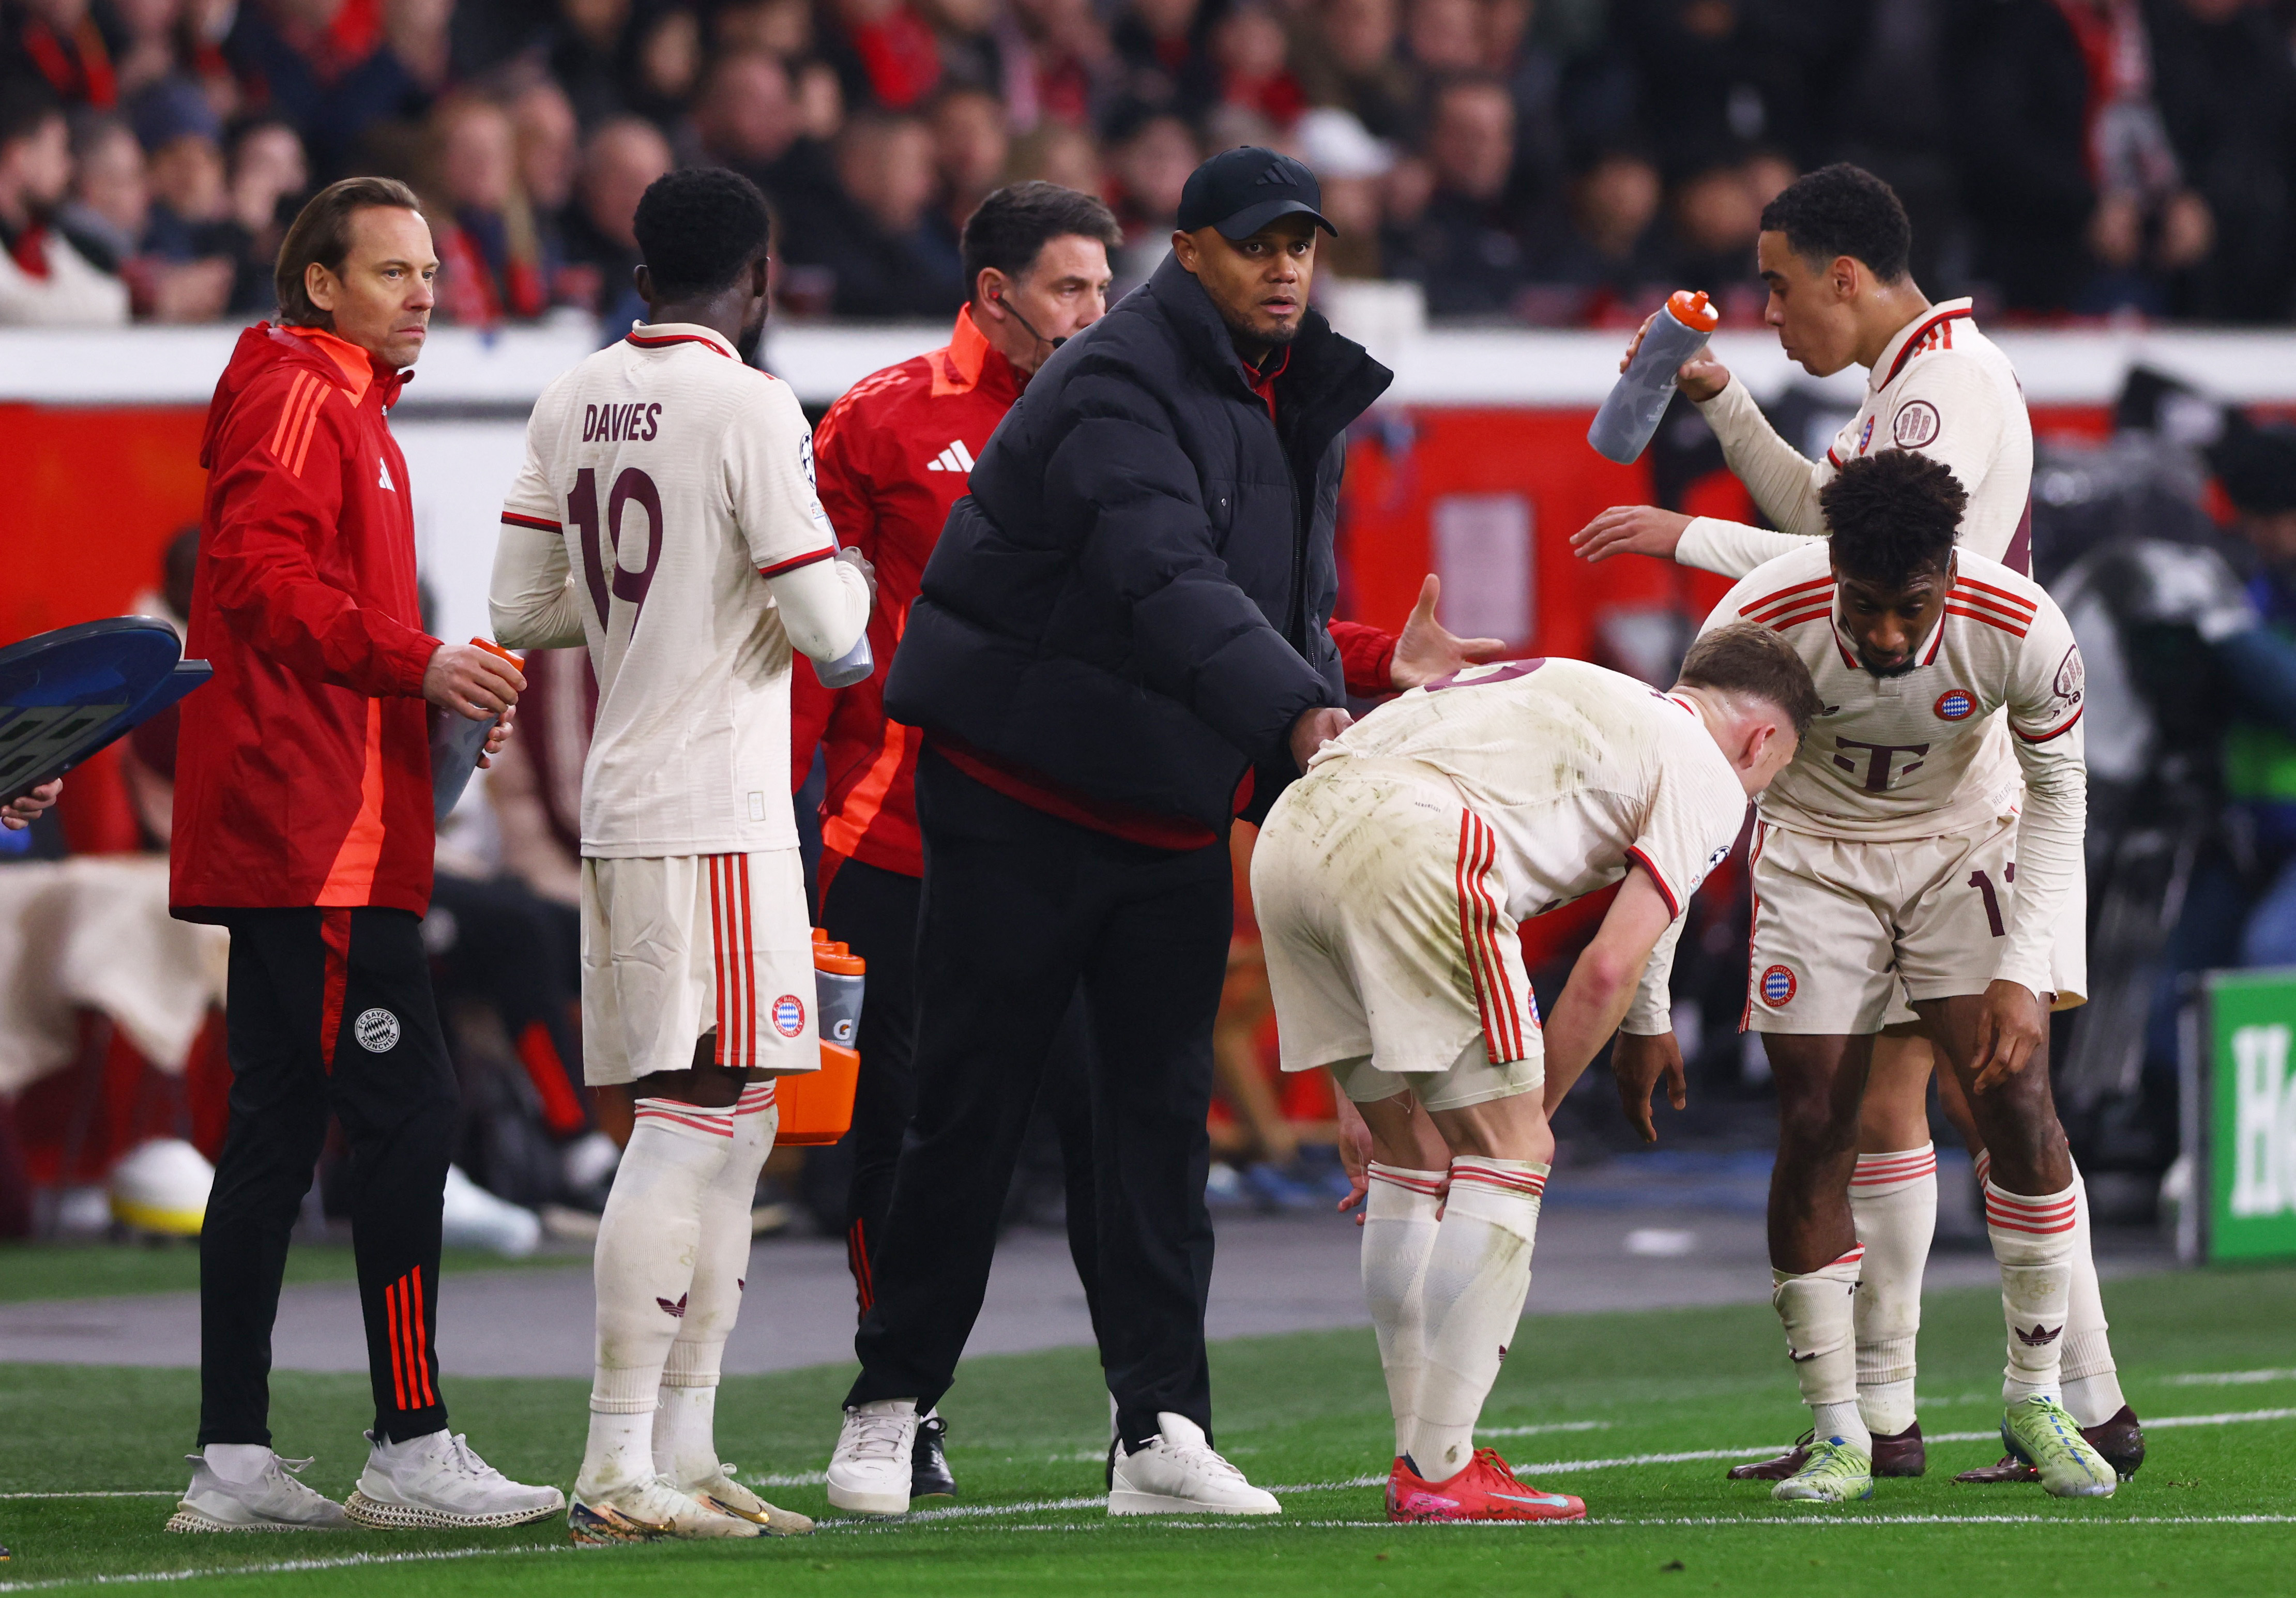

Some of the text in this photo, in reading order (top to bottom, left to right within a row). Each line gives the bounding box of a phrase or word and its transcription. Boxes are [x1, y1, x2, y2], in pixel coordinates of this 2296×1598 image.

[583, 403, 662, 442] DAVIES
[567, 467, 663, 647] 19
[1772, 966, 1793, 980] BAYERN
[358, 1011, 394, 1029] FC BAYERN
[833, 1018, 853, 1040] G
[361, 1032, 396, 1049] MÜNCHEN
